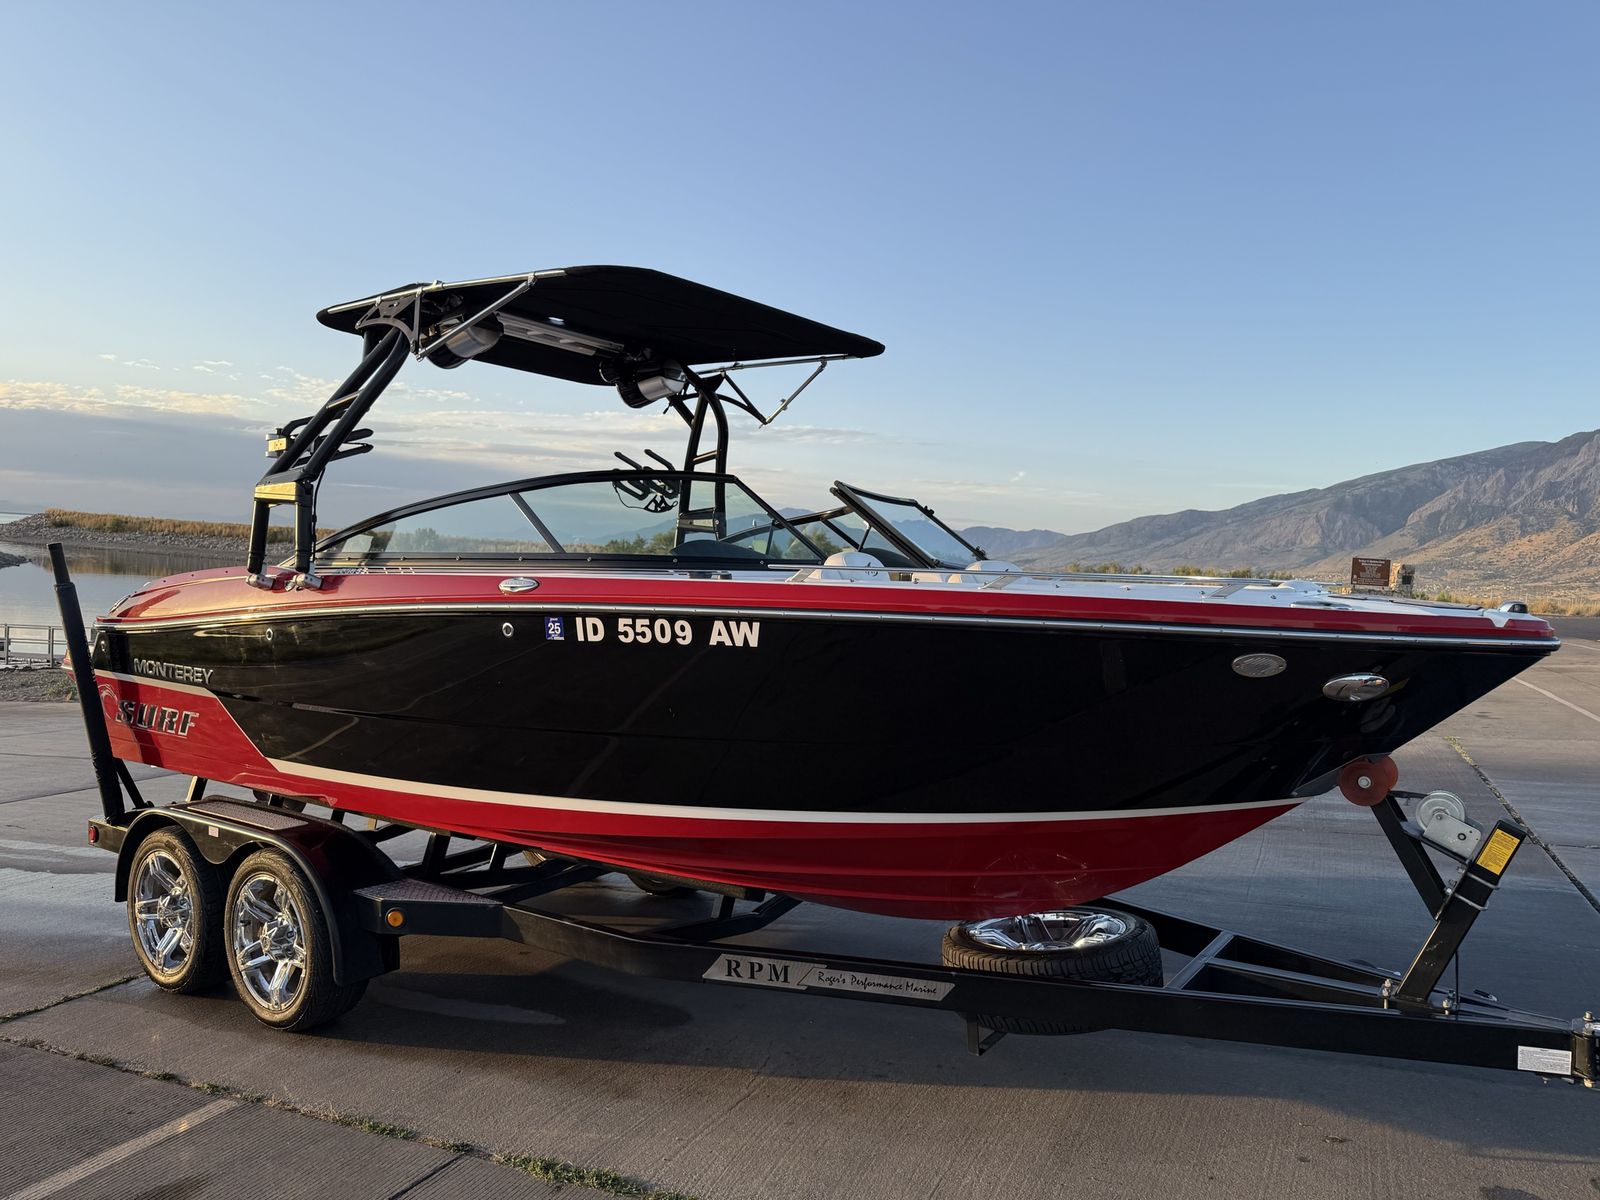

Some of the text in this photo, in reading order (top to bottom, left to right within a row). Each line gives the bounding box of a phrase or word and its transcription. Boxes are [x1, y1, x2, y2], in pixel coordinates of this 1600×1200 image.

[548, 622, 561, 634] 25
[575, 616, 760, 648] ID 5509 AW
[133, 658, 214, 685] MONTEREY
[115, 701, 200, 737] SURF
[725, 959, 790, 983] RPM
[818, 971, 937, 994] Roger's Performance Marine
